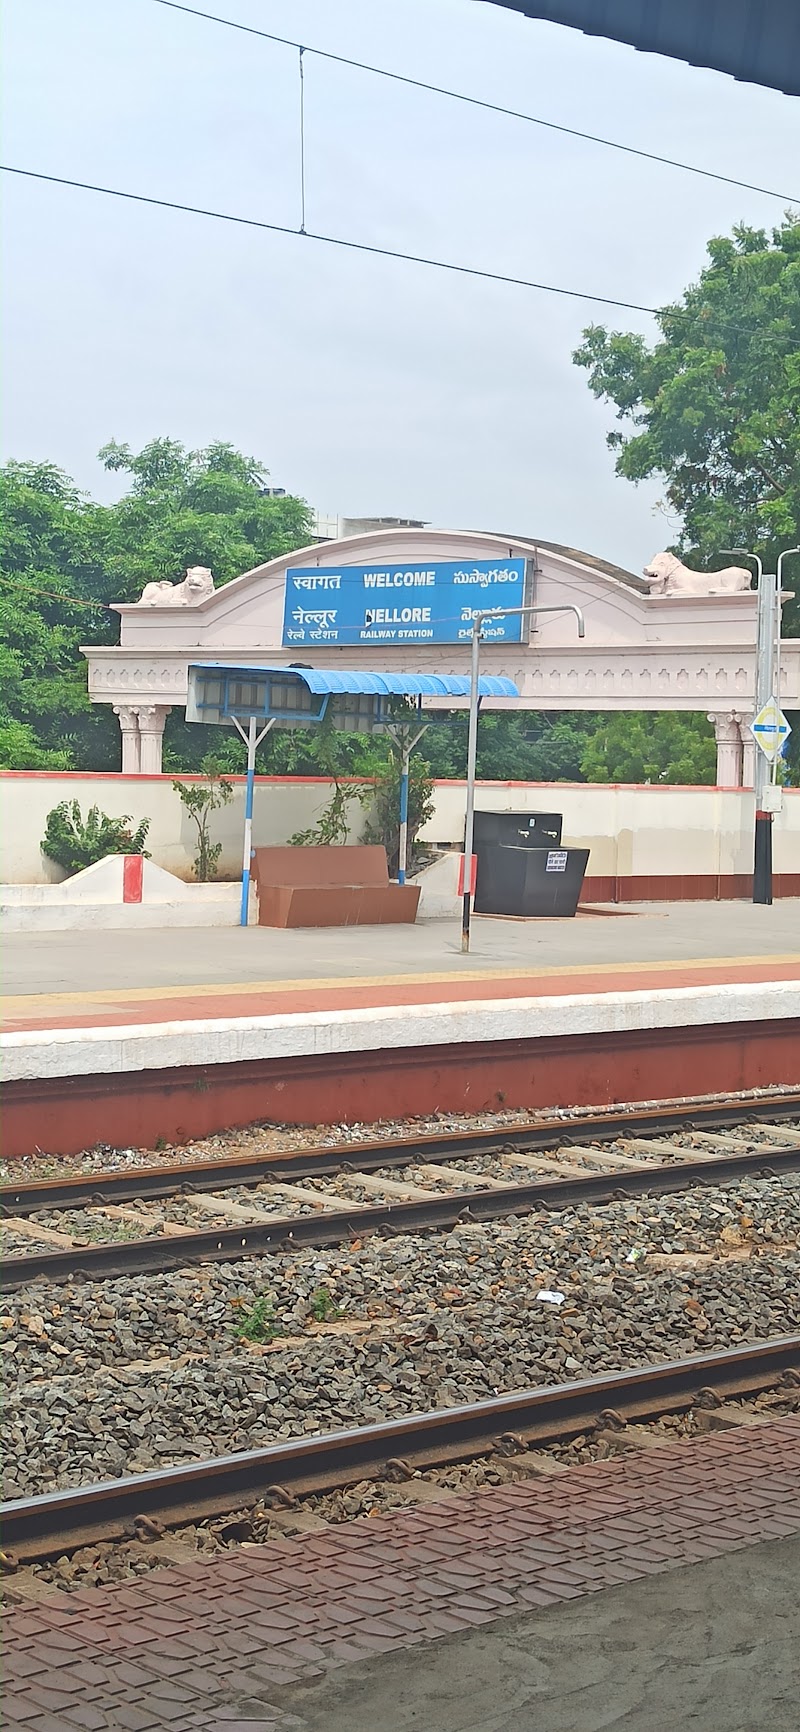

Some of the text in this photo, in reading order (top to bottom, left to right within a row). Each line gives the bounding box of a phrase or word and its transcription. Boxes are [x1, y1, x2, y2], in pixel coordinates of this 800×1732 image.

[292, 574, 342, 590] स्वागत
[363, 571, 436, 588] WELCOME
[453, 568, 519, 588] సుస్వాగతం
[291, 605, 338, 628] नेल्लूर
[364, 607, 432, 624] NELLORE
[309, 628, 339, 640] स्टेशन
[360, 629, 434, 639] RAILWAY STATION
